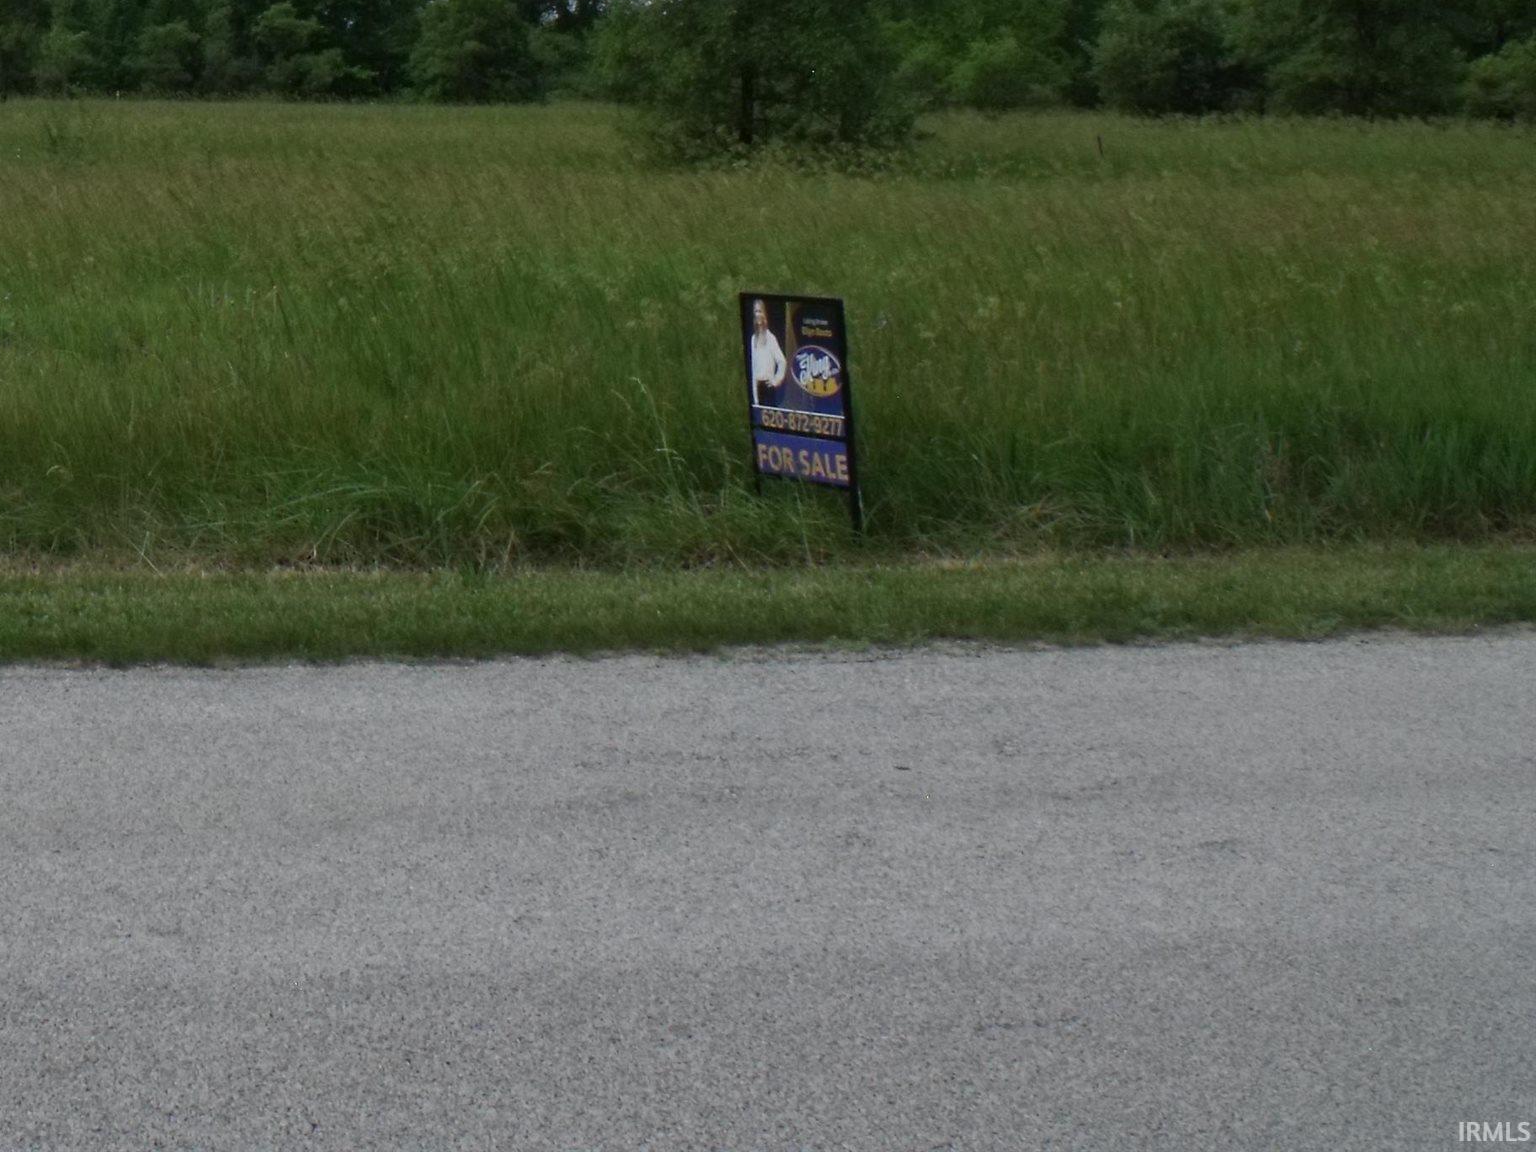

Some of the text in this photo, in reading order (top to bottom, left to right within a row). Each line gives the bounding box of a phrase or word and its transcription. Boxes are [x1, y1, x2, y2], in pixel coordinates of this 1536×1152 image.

[761, 409, 843, 436] 620-872-9277
[757, 443, 849, 481] FOR SALE
